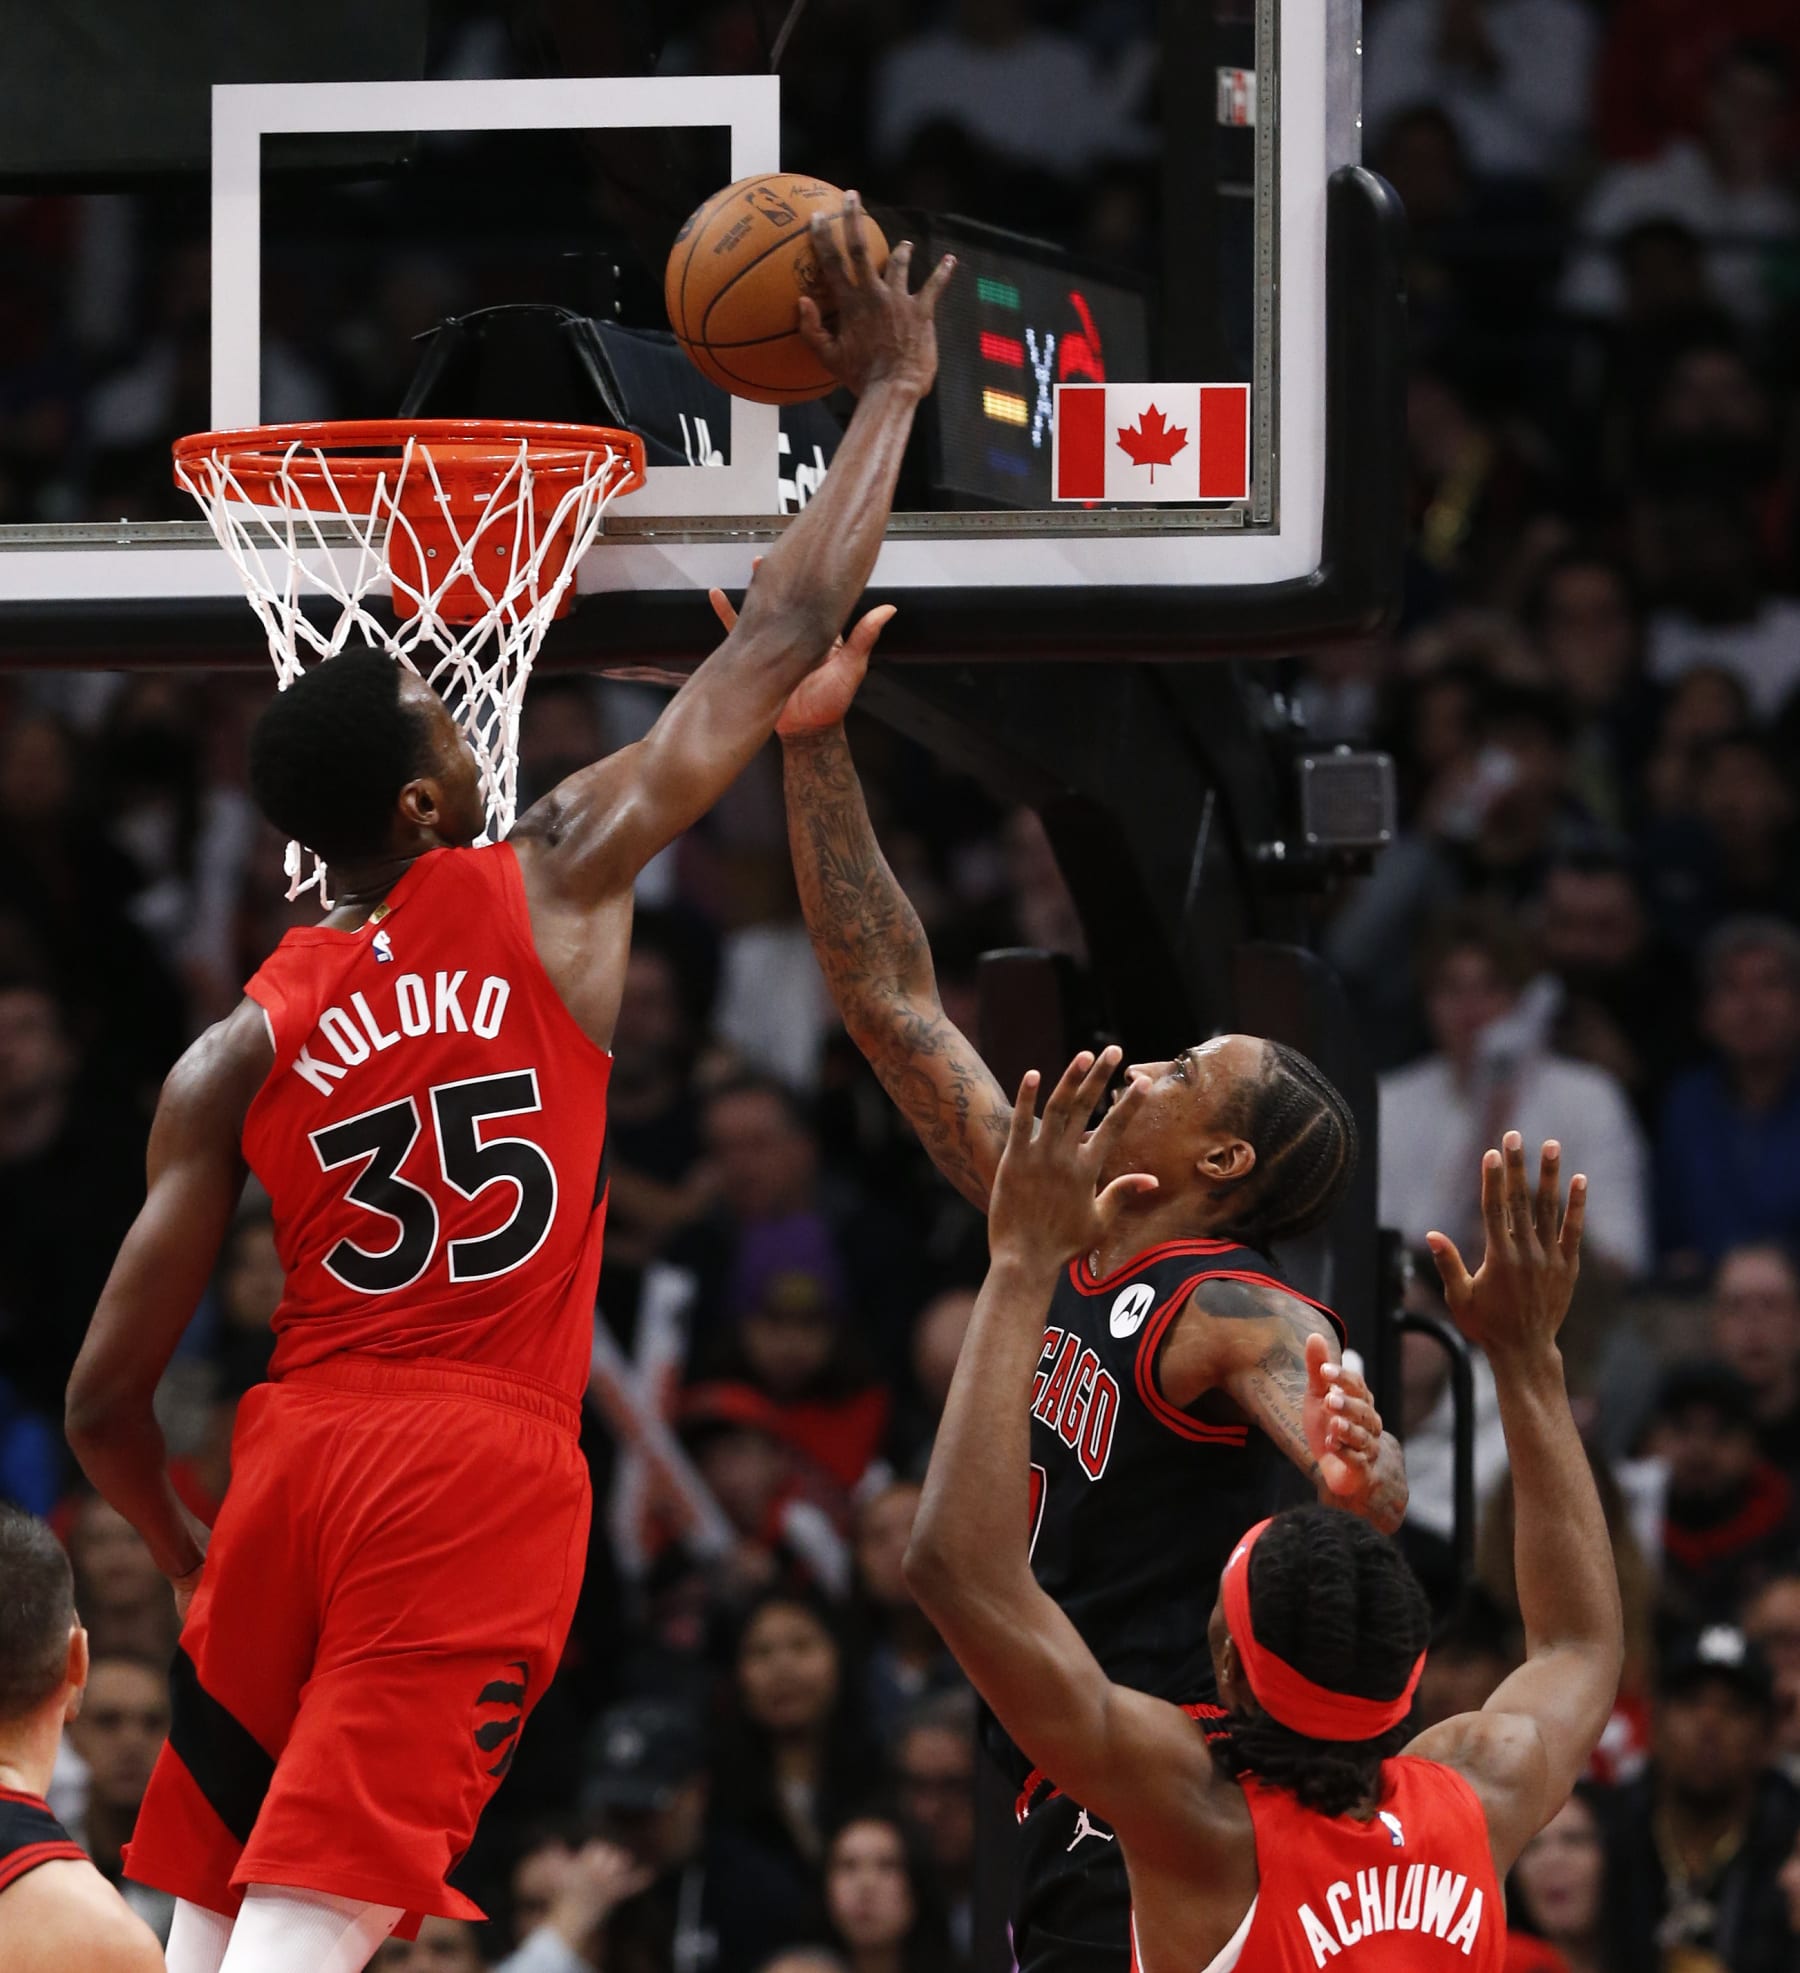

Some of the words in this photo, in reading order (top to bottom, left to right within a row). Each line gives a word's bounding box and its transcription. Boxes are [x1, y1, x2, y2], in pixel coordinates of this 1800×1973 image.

[292, 970, 511, 1097] KOLOKO
[307, 1068, 559, 1295] 35
[1030, 1326, 1120, 1482] CAGO
[1297, 1863, 1484, 1969] ACHIUWA
